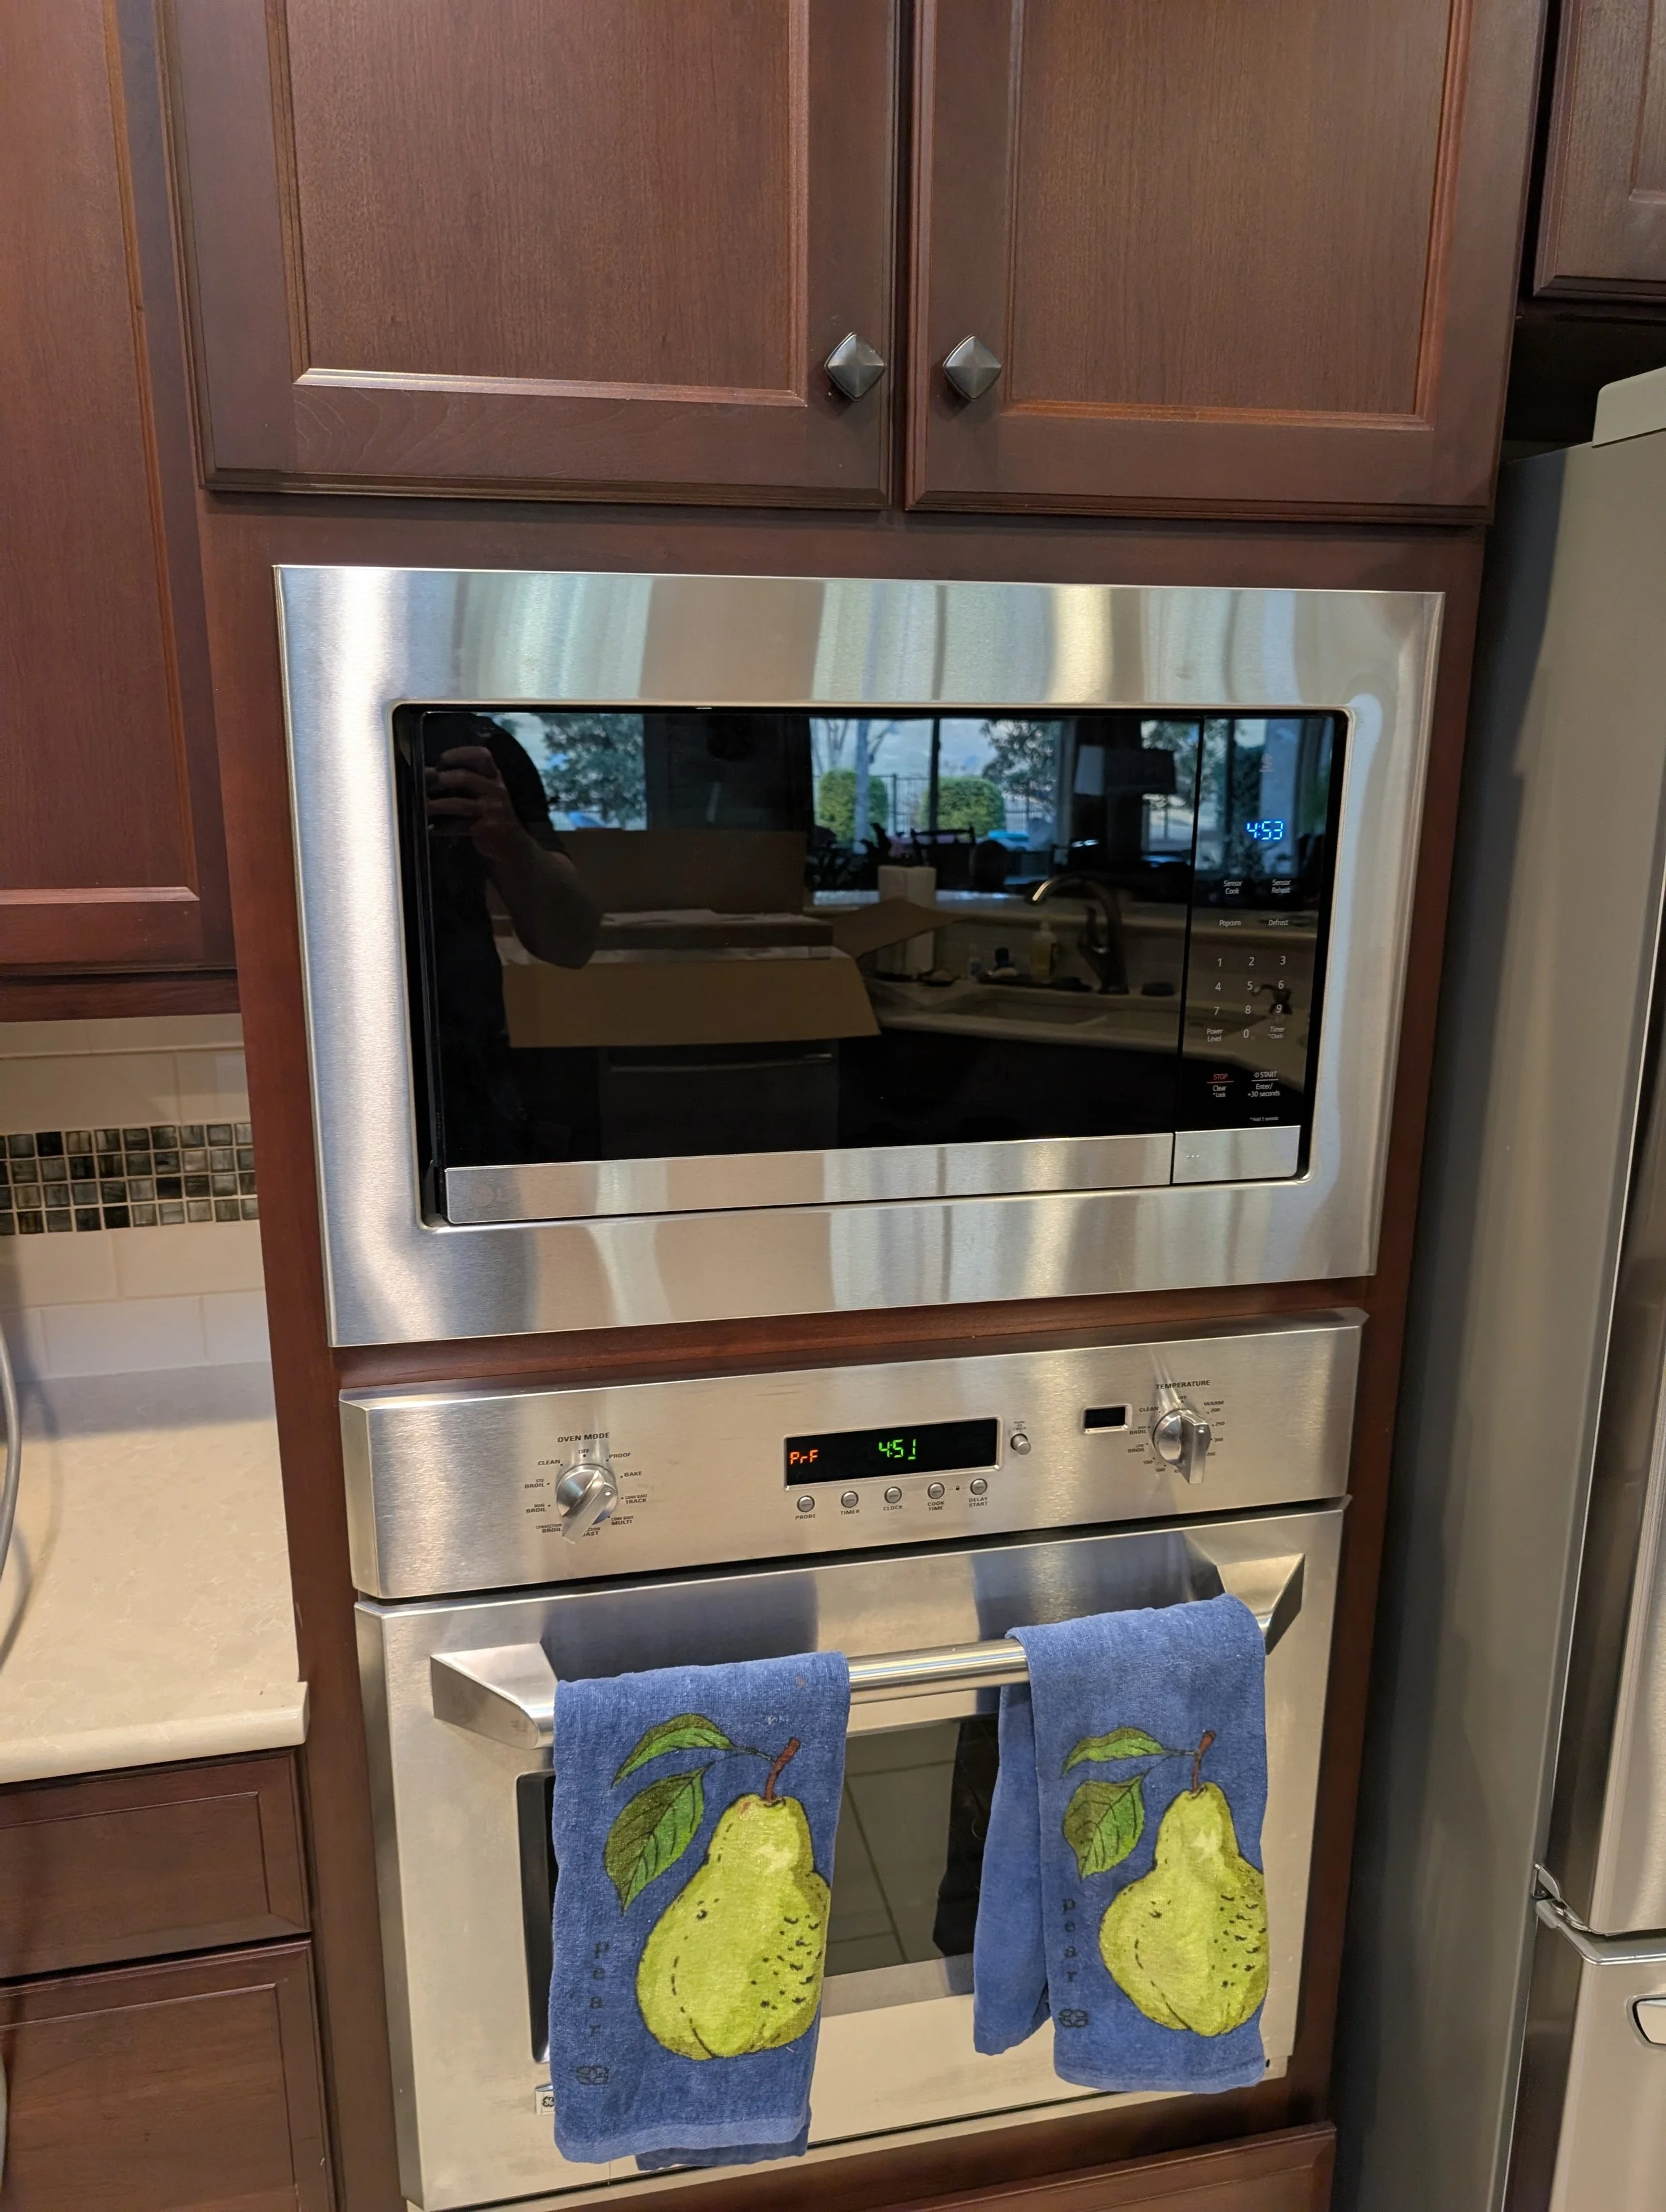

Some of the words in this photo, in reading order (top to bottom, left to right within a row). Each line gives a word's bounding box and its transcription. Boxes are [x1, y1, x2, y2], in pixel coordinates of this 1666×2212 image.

[1247, 821, 1283, 840] 4:53
[1218, 957, 1222, 967] 1
[1248, 957, 1255, 966] 2
[1279, 955, 1286, 965] 3
[1215, 982, 1222, 991] 4
[1247, 981, 1253, 990] 5
[1278, 980, 1284, 989] 6
[1214, 1006, 1220, 1015] 7
[1245, 1005, 1251, 1014] 8
[1275, 1004, 1282, 1013] 9
[1244, 1029, 1250, 1038] 0
[1156, 1380, 1211, 1390] TEMPERATURE
[557, 1434, 582, 1443] OVEN
